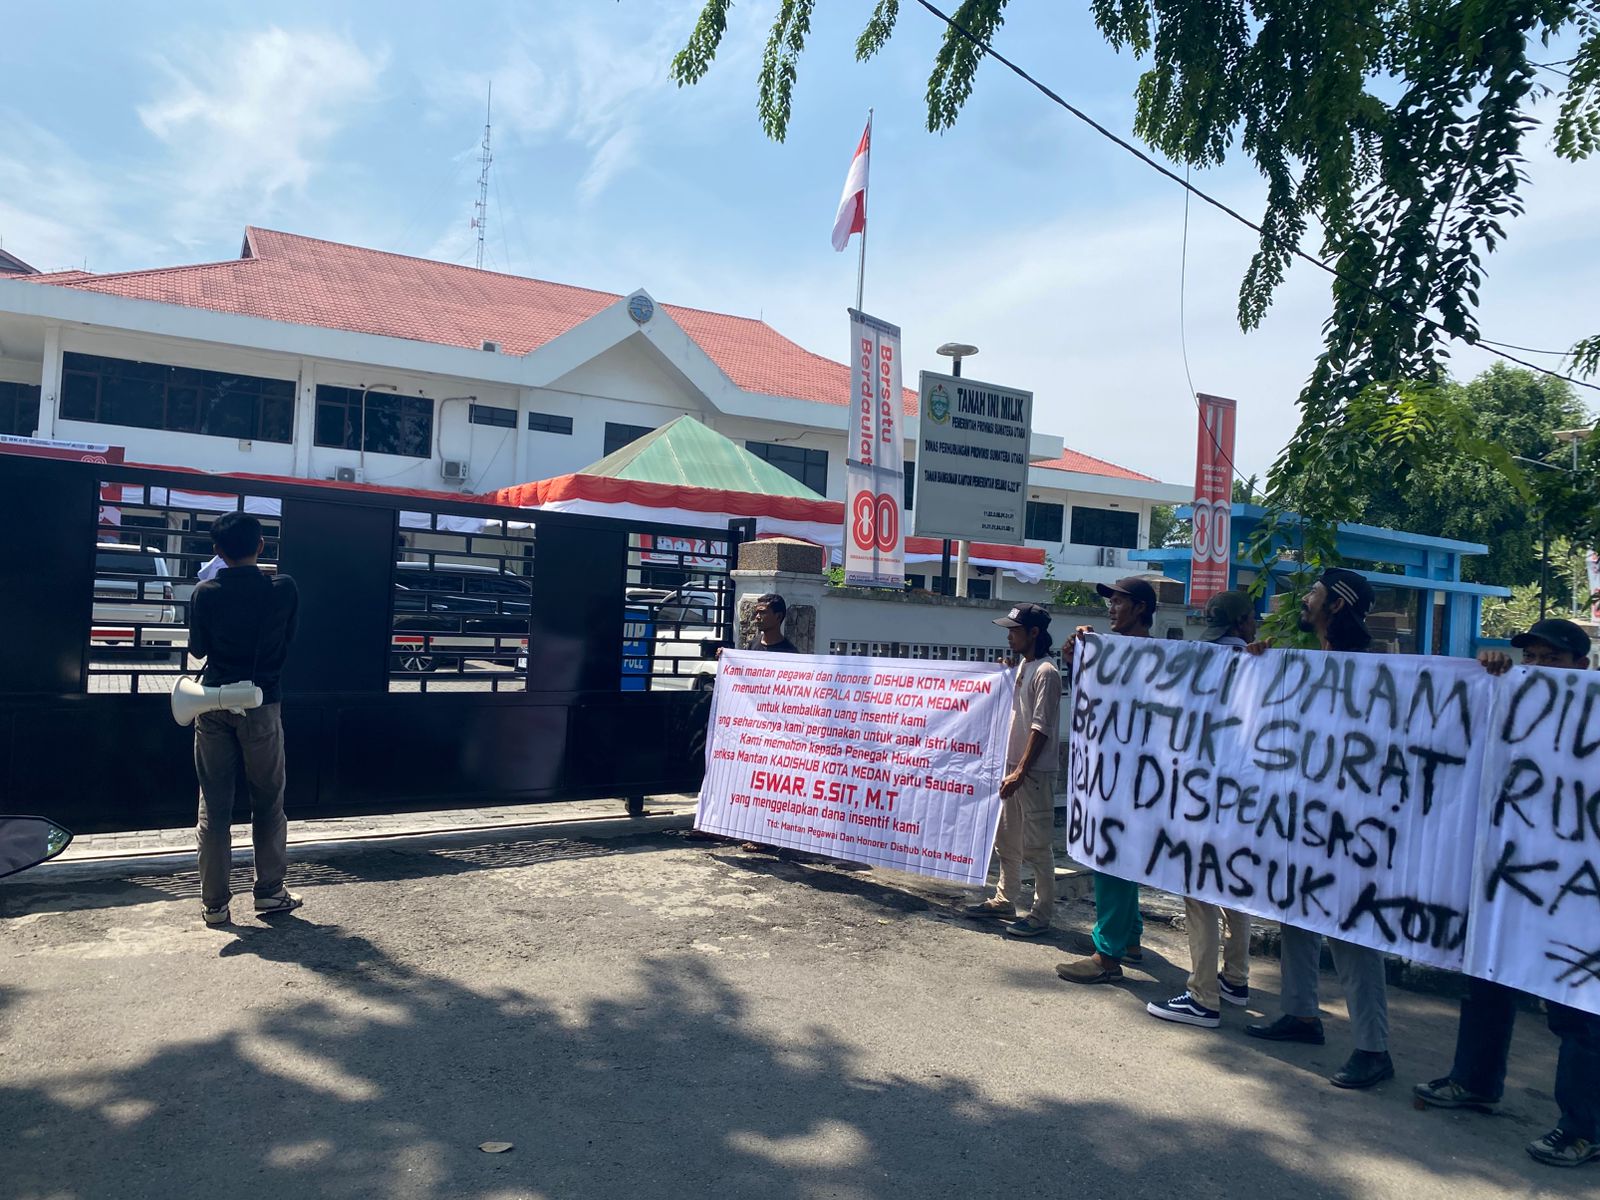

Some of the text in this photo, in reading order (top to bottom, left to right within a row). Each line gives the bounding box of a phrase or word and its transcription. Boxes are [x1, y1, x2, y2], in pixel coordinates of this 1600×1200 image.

[861, 337, 874, 466] Berdaulat
[880, 344, 893, 443] Bersatu
[957, 388, 1024, 423] TANAH INI MILIK
[925, 439, 938, 453] DINAS
[939, 441, 970, 457] PERHUBUNGAN
[1011, 452, 1024, 464] UTARA
[1014, 427, 1025, 439] UTARA
[853, 489, 898, 553] 80
[1191, 496, 1231, 564] 80
[723, 664, 992, 695] Kami mantan pegawai dan honorer DISHUB KOTA MEDAN
[731, 683, 969, 712] menuntut MANTAN KEPALA DISHUB KOTA MEDAN
[1261, 653, 1472, 748] DALAM
[756, 701, 927, 728] untuk kembalikan uang insentif kami
[732, 716, 782, 733] seharusnya
[784, 721, 805, 734] kami
[805, 725, 860, 741] pergunakan
[863, 730, 893, 744] untuk
[895, 734, 921, 748] anak
[925, 735, 947, 750] istri
[950, 738, 983, 757] kami,
[739, 733, 930, 768] Kami memohon kepada Penegak Hukum
[1073, 691, 1467, 816] BENTUK SURAT
[736, 750, 768, 765] Mantan
[769, 754, 820, 772] KADISHUB
[821, 761, 848, 777] KOTA
[851, 765, 891, 783] MEDAN
[892, 773, 922, 787] yaitu
[924, 776, 974, 796] Saudara
[750, 770, 898, 812] ISWAR. S.SIT, M.T
[730, 793, 920, 835] yang menggelapkan dana insentif kami
[780, 822, 806, 834] Mantan
[807, 826, 838, 840] Pegawai
[839, 832, 855, 843] Dan
[856, 835, 888, 849] Honorer
[890, 841, 919, 855] Dishub
[921, 848, 942, 859] Kota
[944, 851, 974, 865] Medan
[1068, 798, 1125, 867] BUS
[1145, 828, 1335, 918] MASUK
